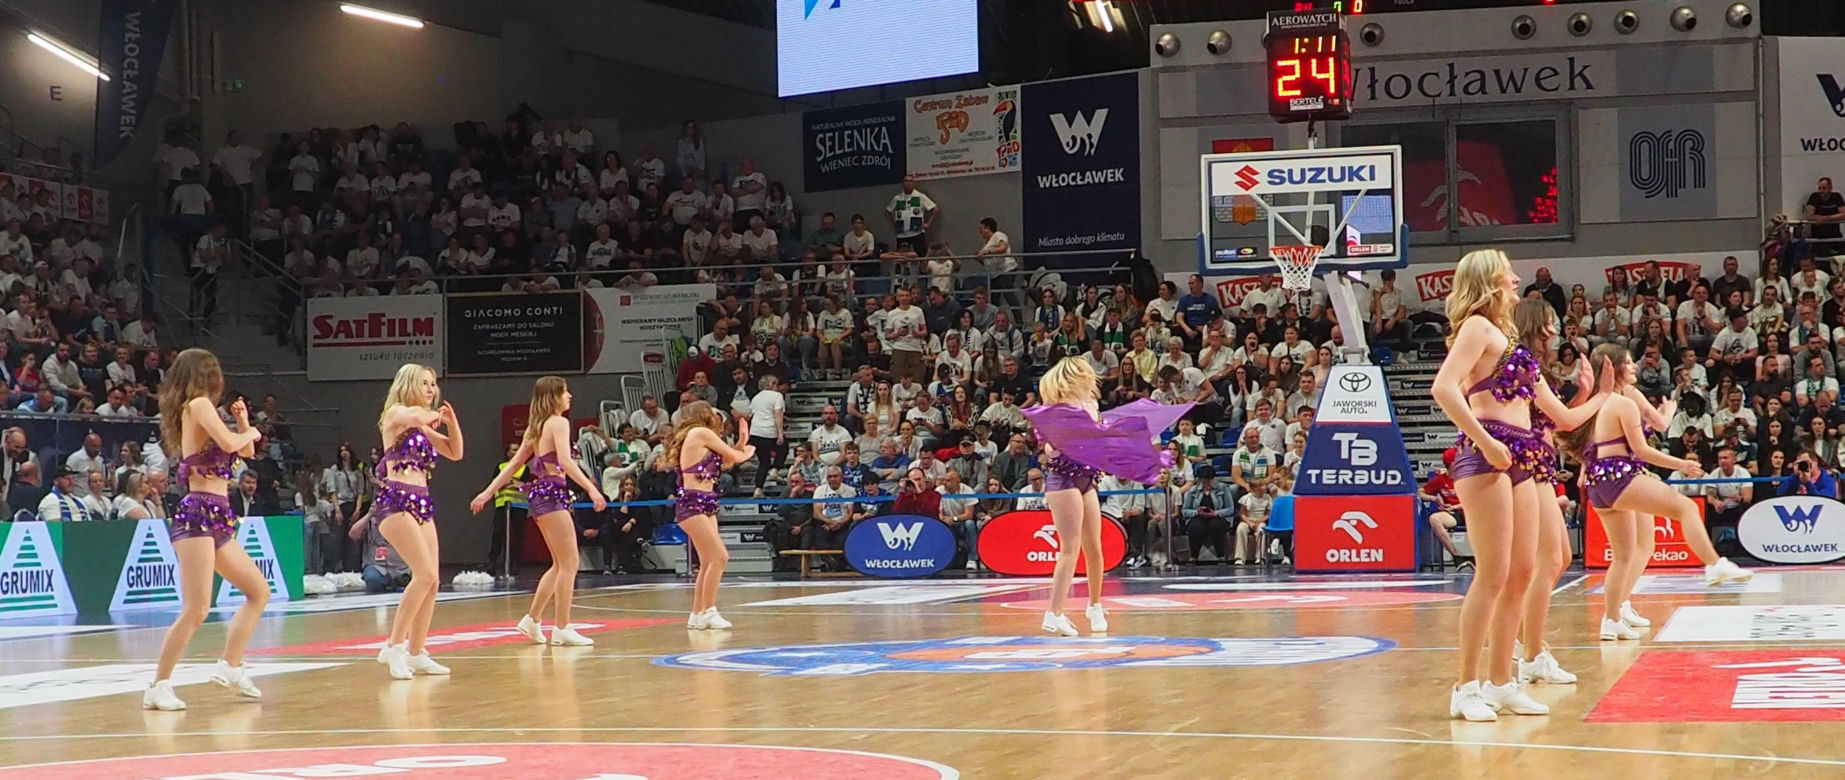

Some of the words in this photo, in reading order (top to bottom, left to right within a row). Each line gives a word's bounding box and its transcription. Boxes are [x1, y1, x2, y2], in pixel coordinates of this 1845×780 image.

[1271, 13, 1337, 26] AEROWATCH
[1294, 35, 1337, 54] 1:11
[1277, 57, 1336, 96] 24
[816, 126, 893, 162] SELENKA
[820, 155, 859, 173] WIENIEC
[861, 153, 891, 170] ZDRÓJ
[1037, 168, 1124, 188] WŁOCŁAWEK
[1267, 165, 1376, 186] SUZUKI
[1038, 235, 1064, 247] Miasto
[1065, 233, 1096, 246] dobrego
[1097, 232, 1125, 242] klimatu
[464, 308, 521, 318] GIACOMO
[526, 306, 563, 316] CONTI
[1332, 400, 1377, 408] JAWORSKI
[1306, 469, 1402, 485] TERBUD
[1326, 549, 1384, 563] ORLEN
[1653, 549, 1688, 561] ekao
[1762, 543, 1838, 553] WŁOCŁAWEK
[864, 559, 934, 569] WŁOCŁAWEK
[0, 569, 54, 595] GRUMIX
[127, 563, 175, 588] GRUMIX
